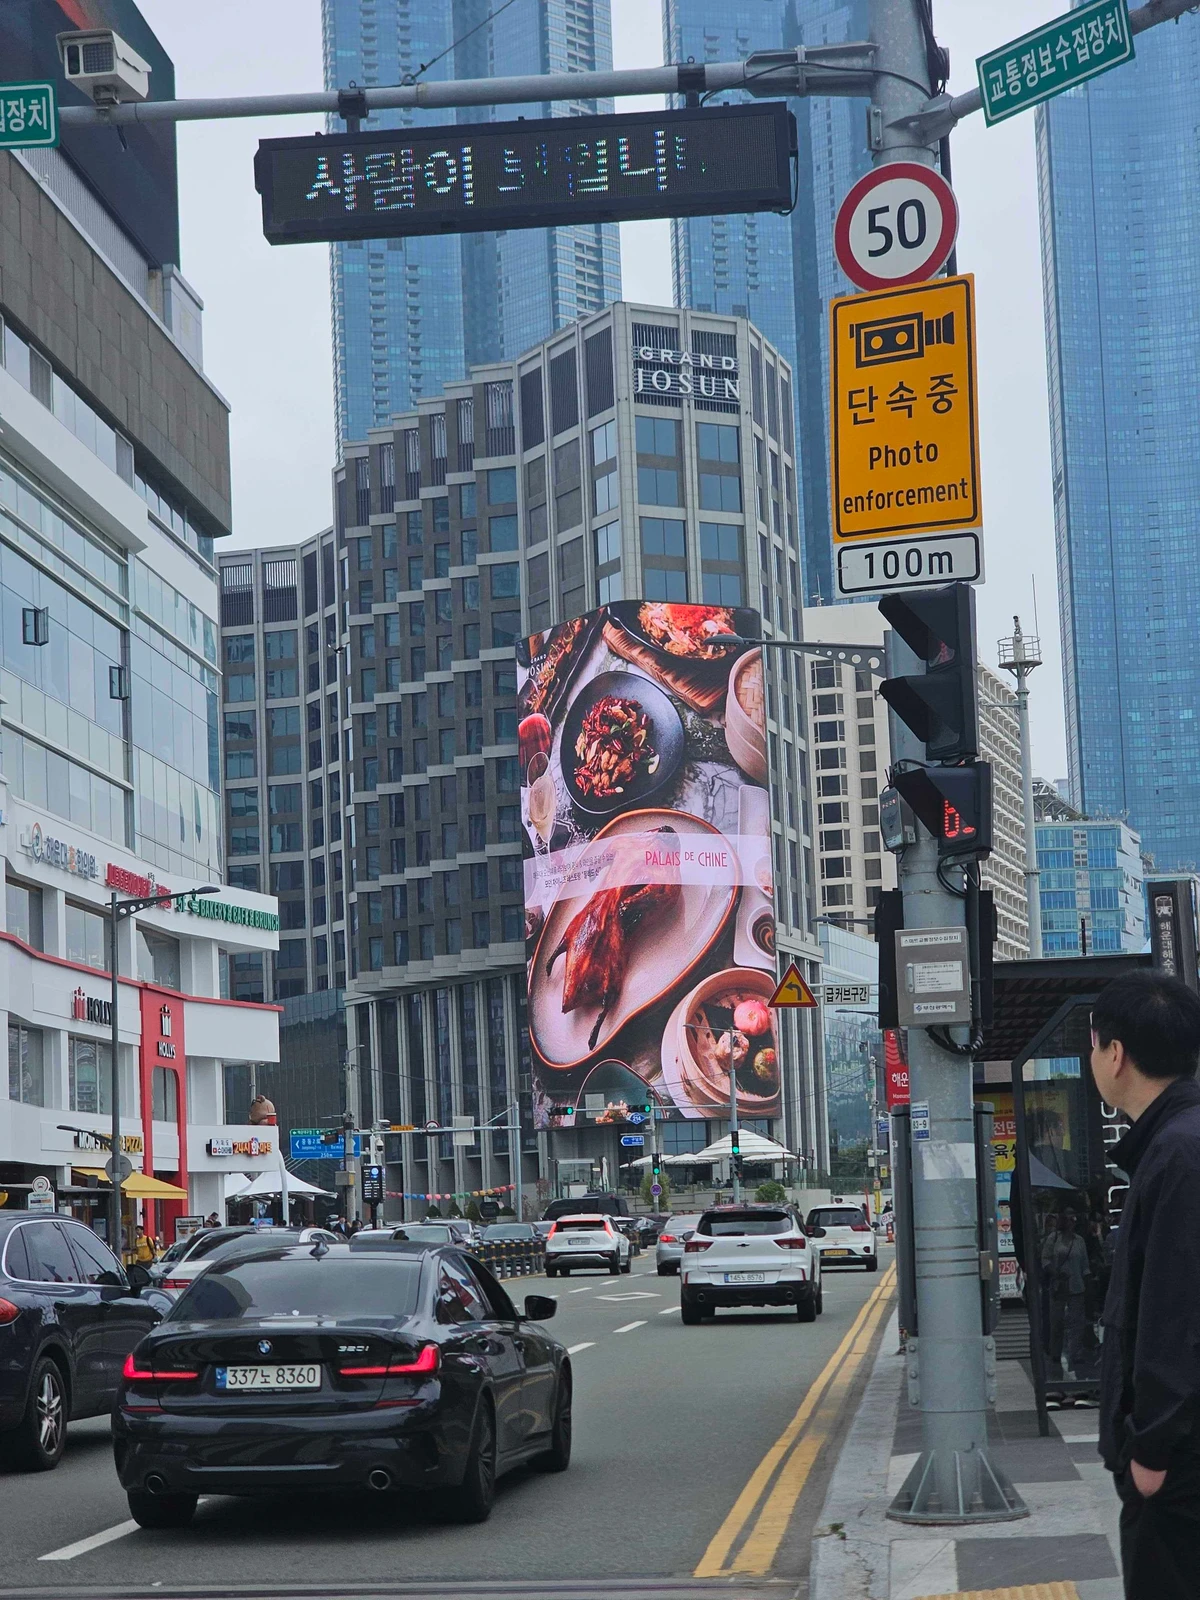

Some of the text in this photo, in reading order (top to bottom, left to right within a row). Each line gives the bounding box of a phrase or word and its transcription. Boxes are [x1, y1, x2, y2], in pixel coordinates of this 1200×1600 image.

[988, 7, 1123, 102] 교통정보수집장치
[306, 147, 475, 212] 사람이
[868, 198, 927, 257] 50
[639, 346, 735, 370] GRAND
[636, 368, 740, 399] JOSUN
[869, 440, 939, 470] Photo
[843, 477, 969, 514] enforcement
[864, 548, 954, 580] 100m
[645, 851, 728, 867] PALAIS DE CHINE
[825, 986, 868, 1003] 급커브구간
[158, 1041, 176, 1059] HOLLYS
[891, 1072, 909, 1087] 해운
[276, 1367, 316, 1384] 8360
